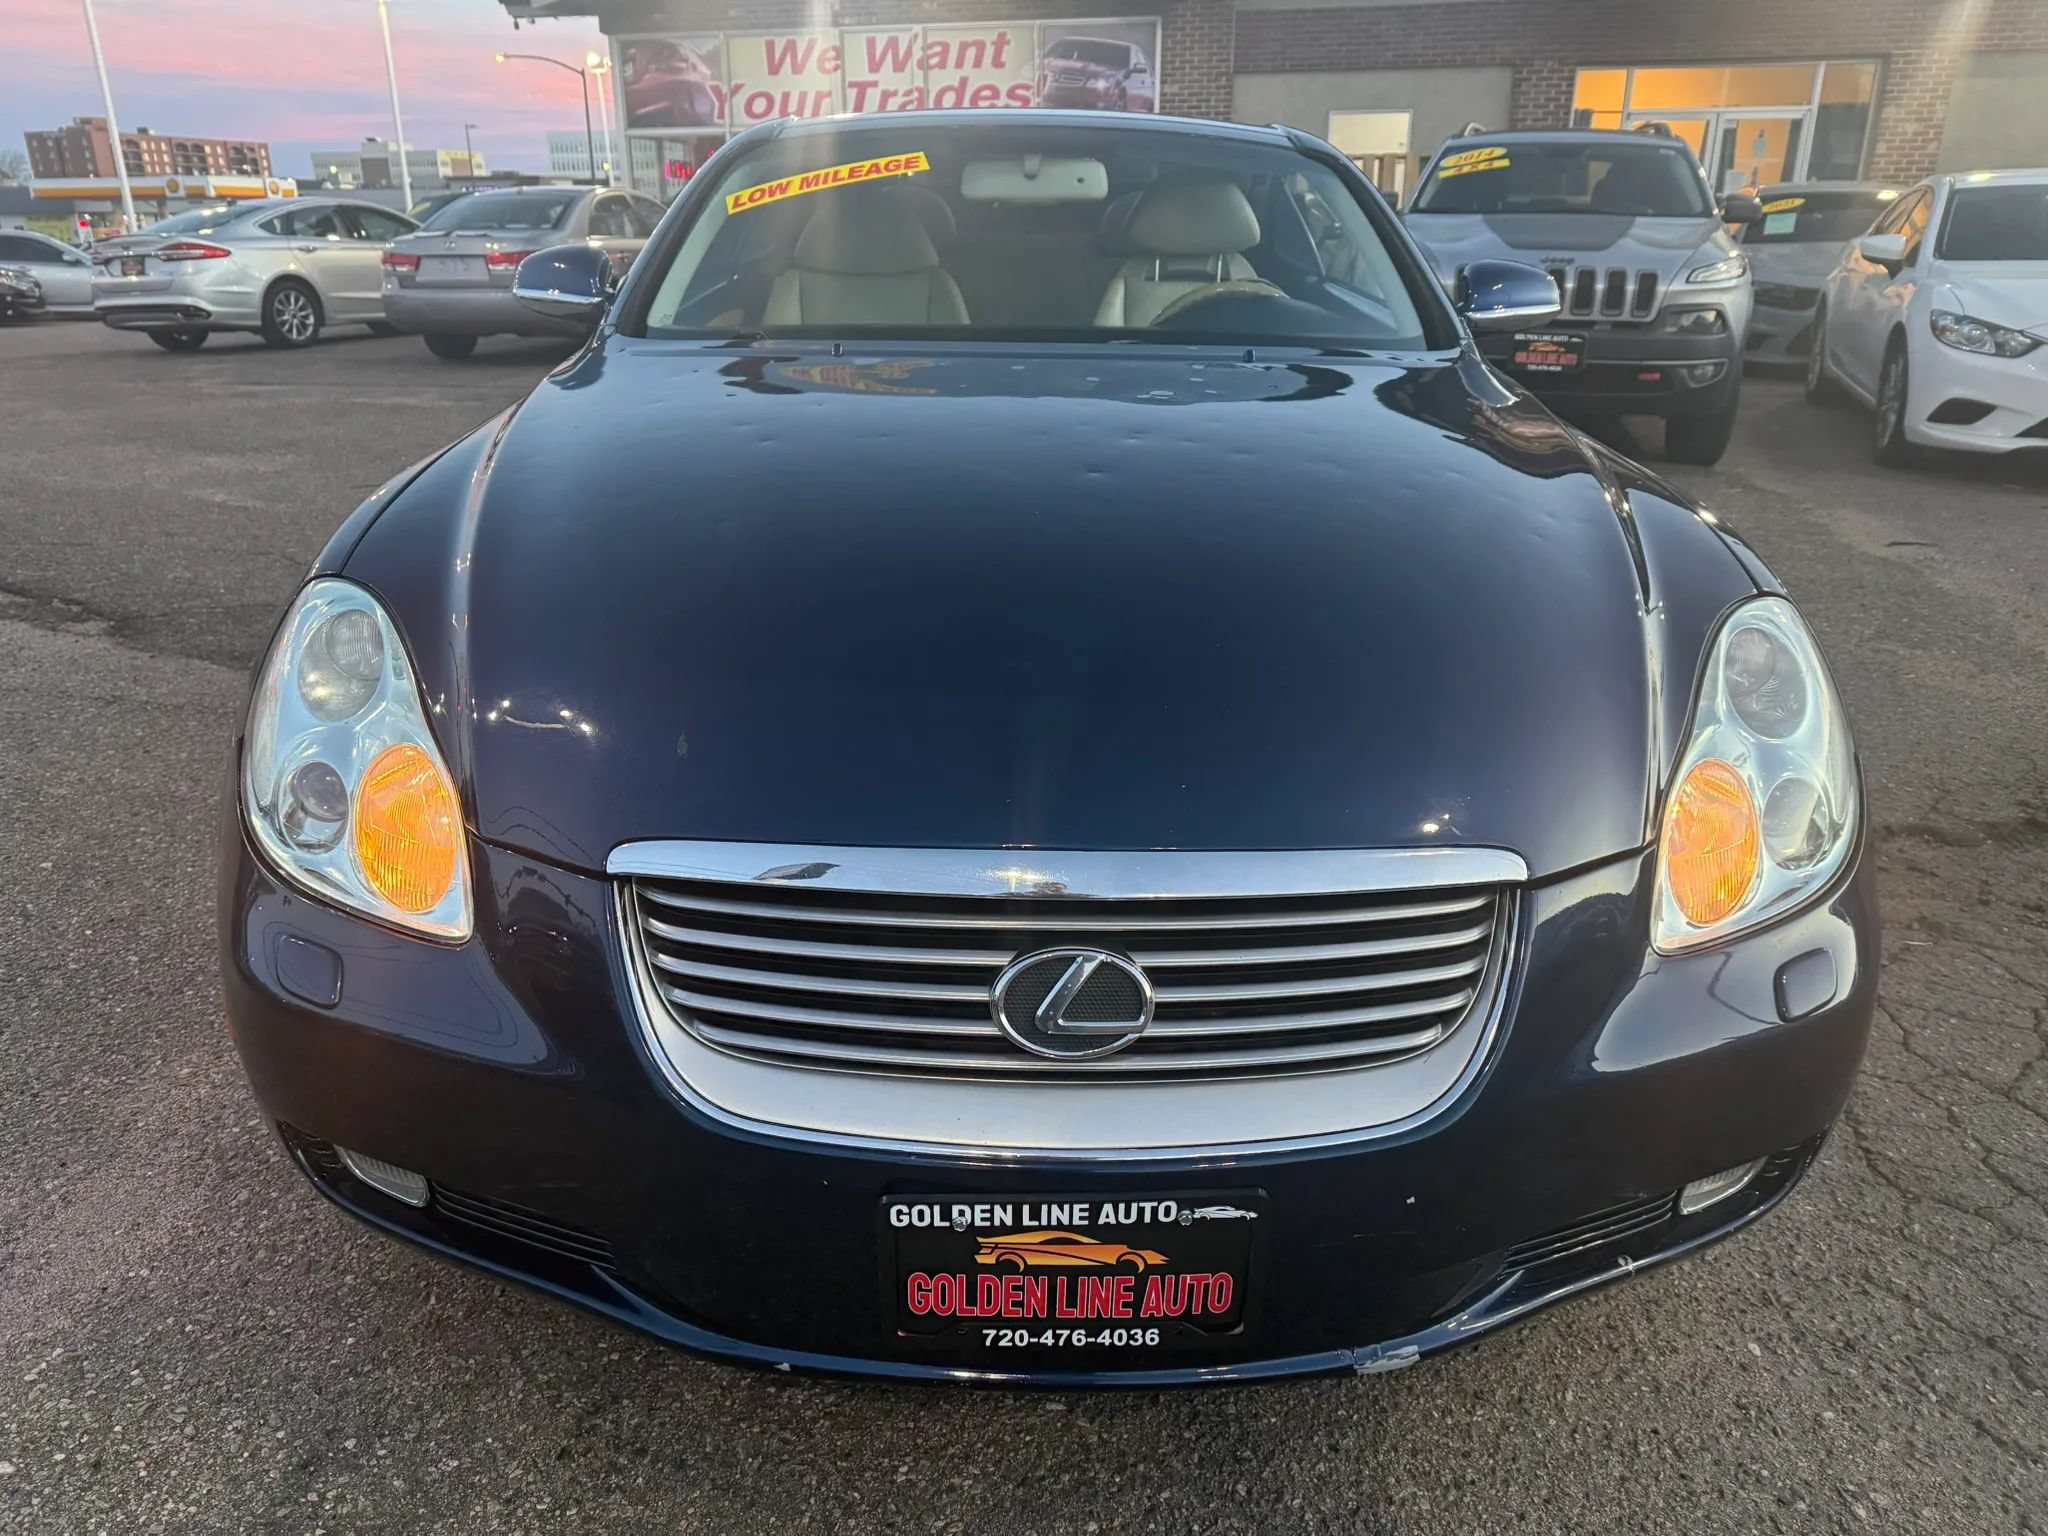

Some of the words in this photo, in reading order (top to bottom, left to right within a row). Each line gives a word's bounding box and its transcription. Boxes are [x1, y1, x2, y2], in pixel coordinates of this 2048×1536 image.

[765, 37, 842, 76] We
[866, 31, 1012, 74] Want
[707, 82, 832, 120] Your
[731, 180, 793, 209] LOW
[798, 155, 922, 191] MILEAGE
[889, 1204, 1013, 1228] GOLDEN
[1022, 1203, 1090, 1226] LINE
[1098, 1200, 1178, 1225] AUTO
[907, 1272, 1048, 1318] GOLDEN
[1056, 1276, 1135, 1318] LINE
[1140, 1272, 1234, 1318] AUTO
[982, 1328, 1160, 1347] 720-476-4036
